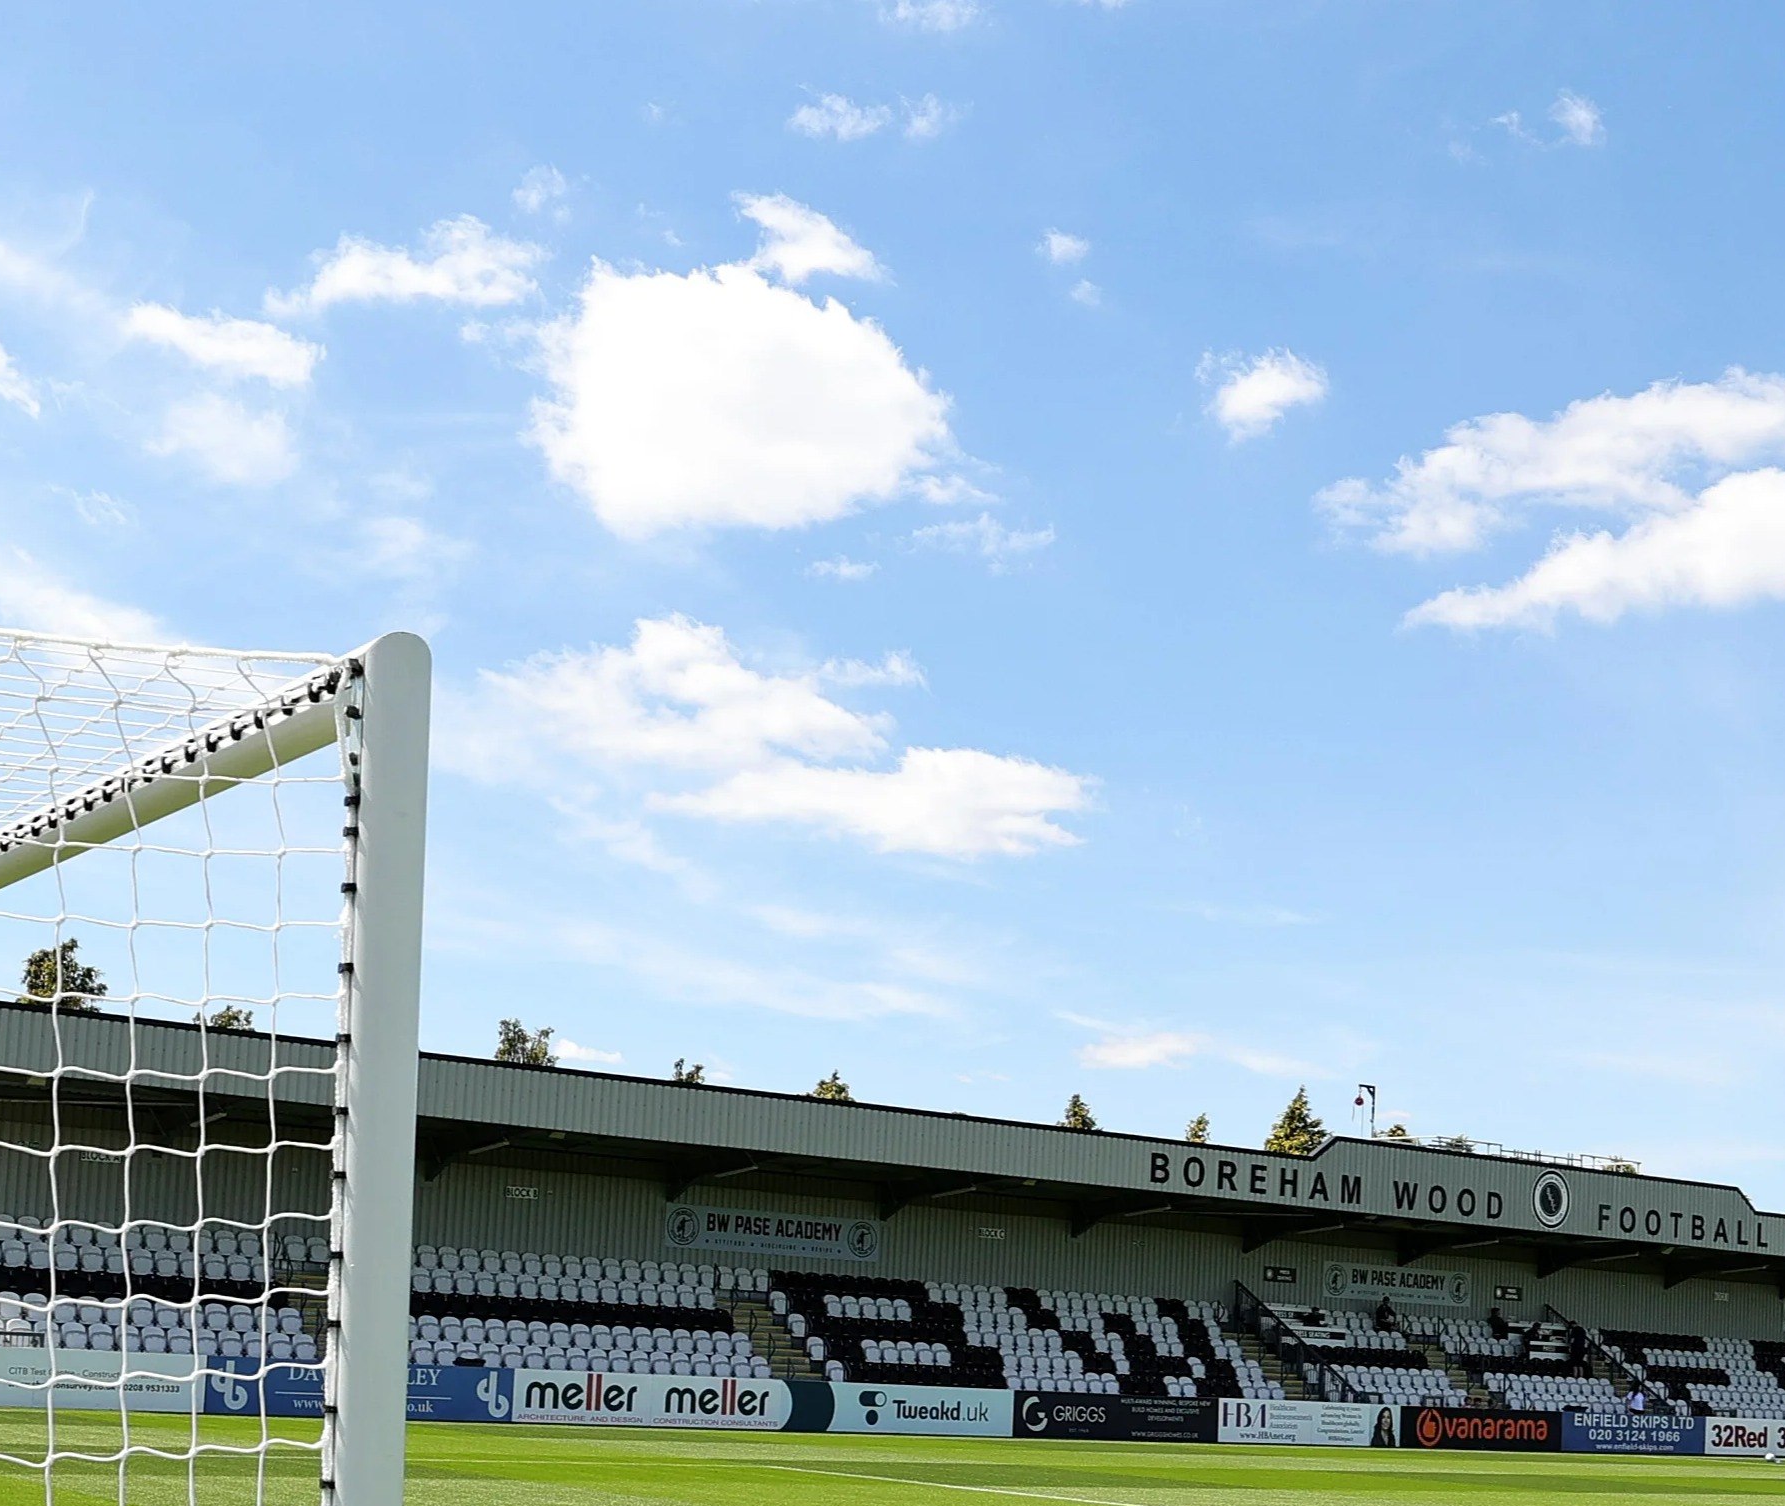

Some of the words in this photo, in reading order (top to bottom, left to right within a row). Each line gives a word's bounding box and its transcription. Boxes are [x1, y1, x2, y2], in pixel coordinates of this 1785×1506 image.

[1150, 1152, 1362, 1205] BOREHAM
[1393, 1180, 1503, 1219] WOOD
[1597, 1204, 1768, 1248] FOOTBALL
[706, 1212, 730, 1233] BW
[734, 1215, 771, 1236] PASE
[774, 1218, 843, 1242] ACADEMY
[1351, 1268, 1369, 1286] BW
[1371, 1270, 1396, 1288] PASE
[1399, 1272, 1446, 1291] ACADEMY
[8, 1366, 28, 1376] CITB
[31, 1367, 47, 1376] Test
[123, 1384, 144, 1392] 0208
[145, 1384, 181, 1393] 9531333
[525, 1373, 638, 1412] meller
[664, 1378, 770, 1417] meller
[517, 1413, 586, 1422] ARCHITECTURE
[611, 1416, 644, 1424] DESIGN
[892, 1399, 989, 1423] Tweakd.uk
[1053, 1404, 1107, 1424] GRIGGS
[1222, 1402, 1266, 1429] HBA
[653, 1417, 719, 1426] CONSTRUCTION
[720, 1419, 779, 1428] CONSULTANTS
[1445, 1416, 1548, 1441] vanarama
[1574, 1413, 1628, 1428] ENFIELD
[1631, 1415, 1669, 1429] SKIPS
[1672, 1416, 1695, 1430] LTD
[1239, 1431, 1297, 1443] www.HBAnet.org
[1588, 1429, 1614, 1441] 020
[1616, 1430, 1647, 1442] 3124
[1651, 1431, 1681, 1443] 1966
[1711, 1424, 1768, 1448] 32Red
[1595, 1442, 1674, 1451] www.enfield-skips.com
